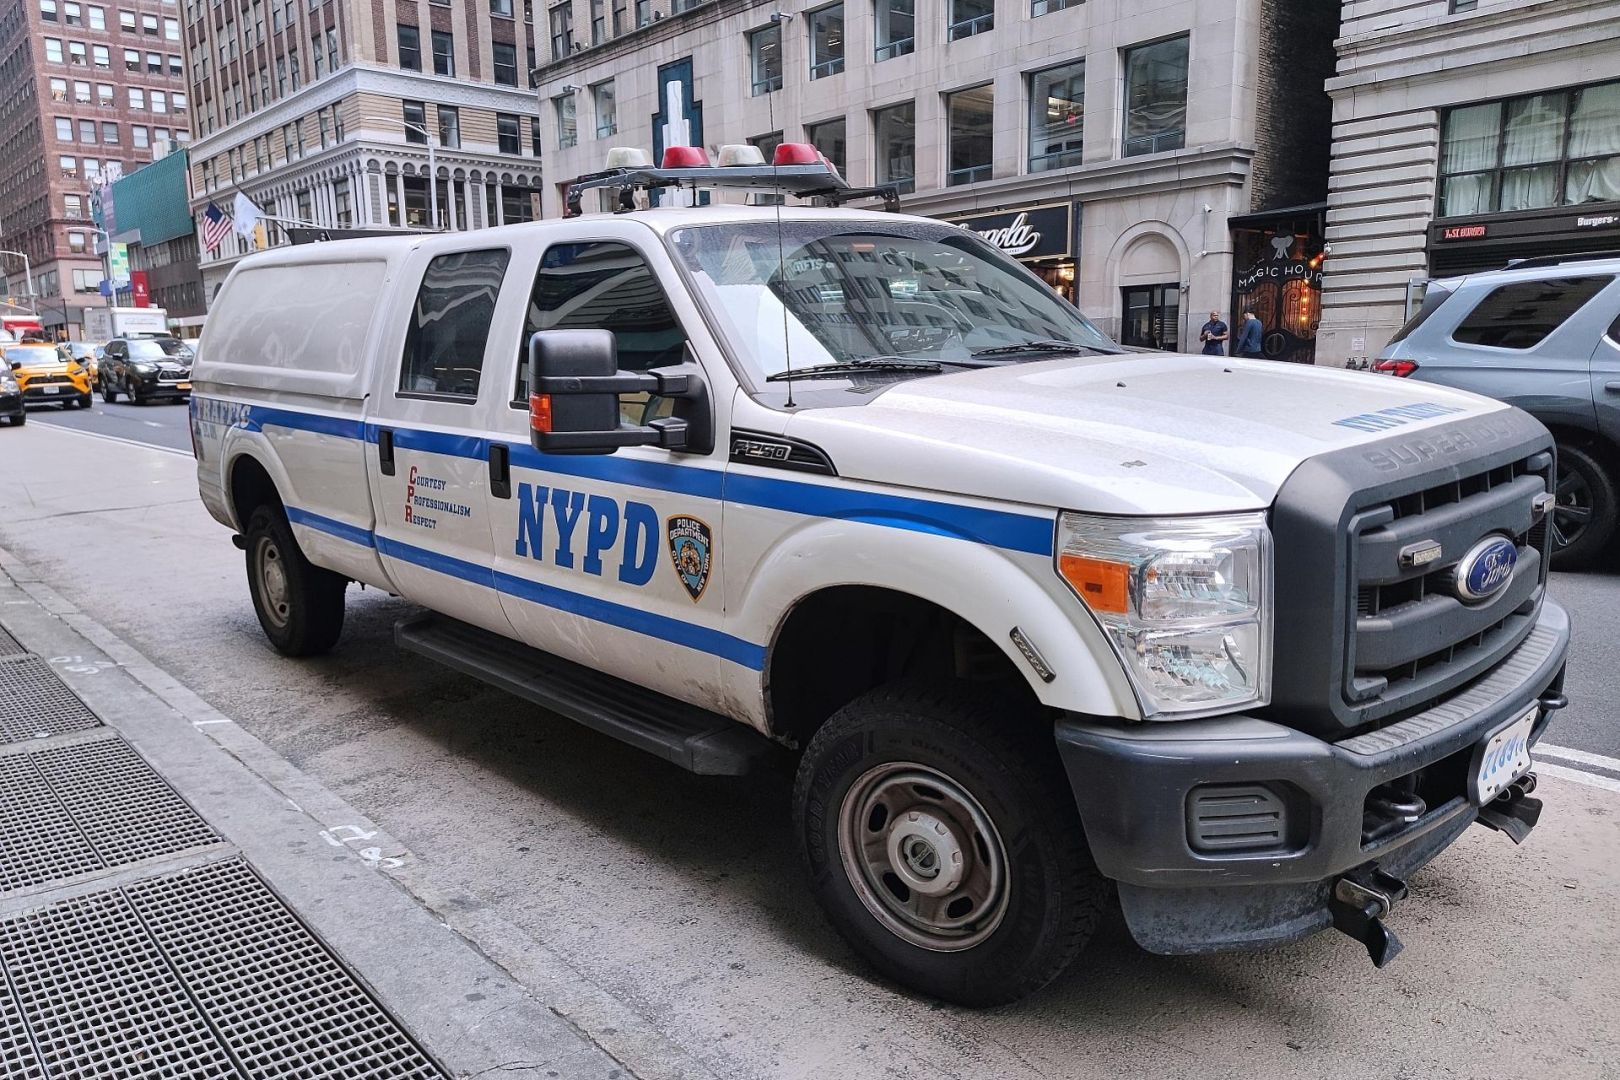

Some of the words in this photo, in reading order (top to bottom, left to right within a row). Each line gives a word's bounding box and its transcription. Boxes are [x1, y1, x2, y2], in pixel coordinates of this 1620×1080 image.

[1577, 216, 1614, 227] Burgers
[1238, 265, 1279, 289] MAGIC
[1361, 428, 1478, 473] SUPER
[409, 465, 447, 491] COURTESY
[406, 485, 471, 517] PROFESSIONALISM
[404, 504, 437, 529] RESPECT
[676, 518, 701, 532] POLICE
[515, 482, 660, 586] NYPD
[669, 527, 709, 548] DEPARTMENT
[671, 550, 683, 571] CITY
[1480, 543, 1512, 589] Ford
